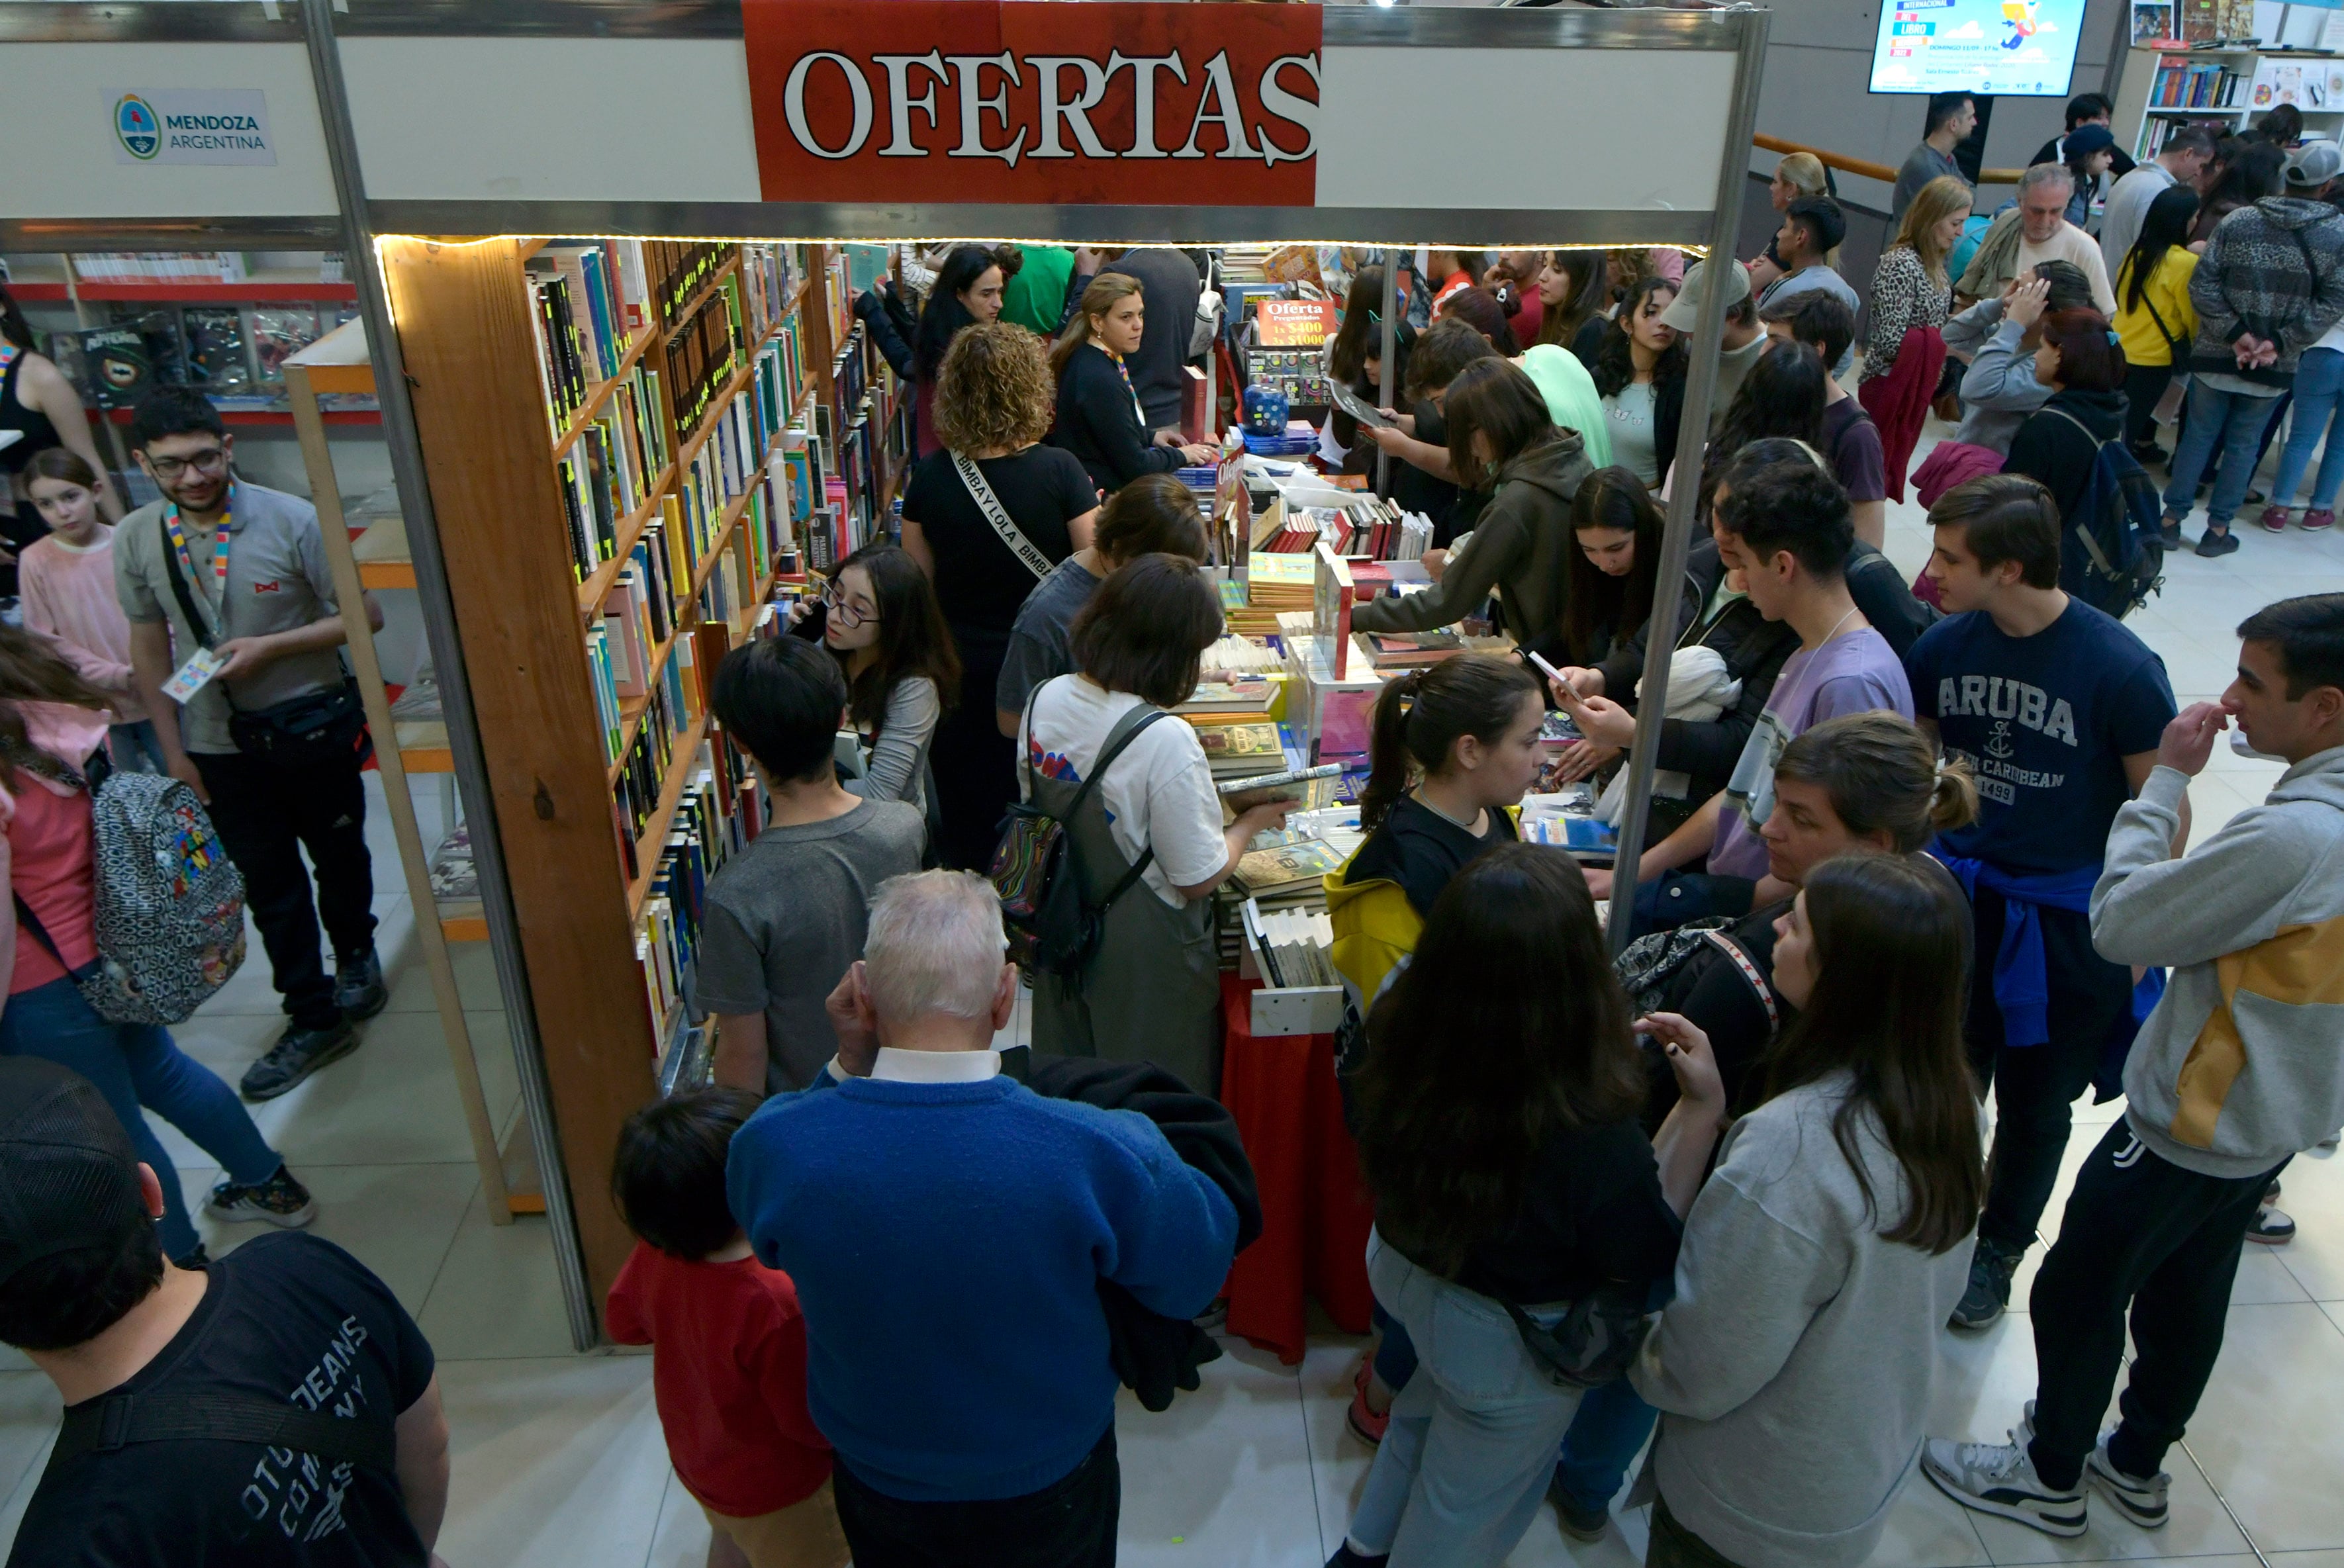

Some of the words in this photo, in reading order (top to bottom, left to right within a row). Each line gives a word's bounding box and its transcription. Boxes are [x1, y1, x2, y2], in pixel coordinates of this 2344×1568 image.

[1903, 0, 1947, 9] INTERNACIONAL
[1900, 24, 1926, 34] LIBRO
[783, 46, 1320, 168] OFERTAS
[165, 115, 259, 131] MENDOZA
[169, 135, 266, 150] ARGENTINA
[1267, 302, 1323, 314] Oferta
[1288, 322, 1323, 334] $400
[1288, 334, 1325, 346] $1000
[957, 456, 986, 498] BIMBA
[982, 494, 994, 506] Y
[988, 506, 1017, 543] LOLA
[1938, 675, 2078, 747] ARUBA
[1981, 782, 2010, 800] 1499
[291, 1314, 367, 1412] JEANS
